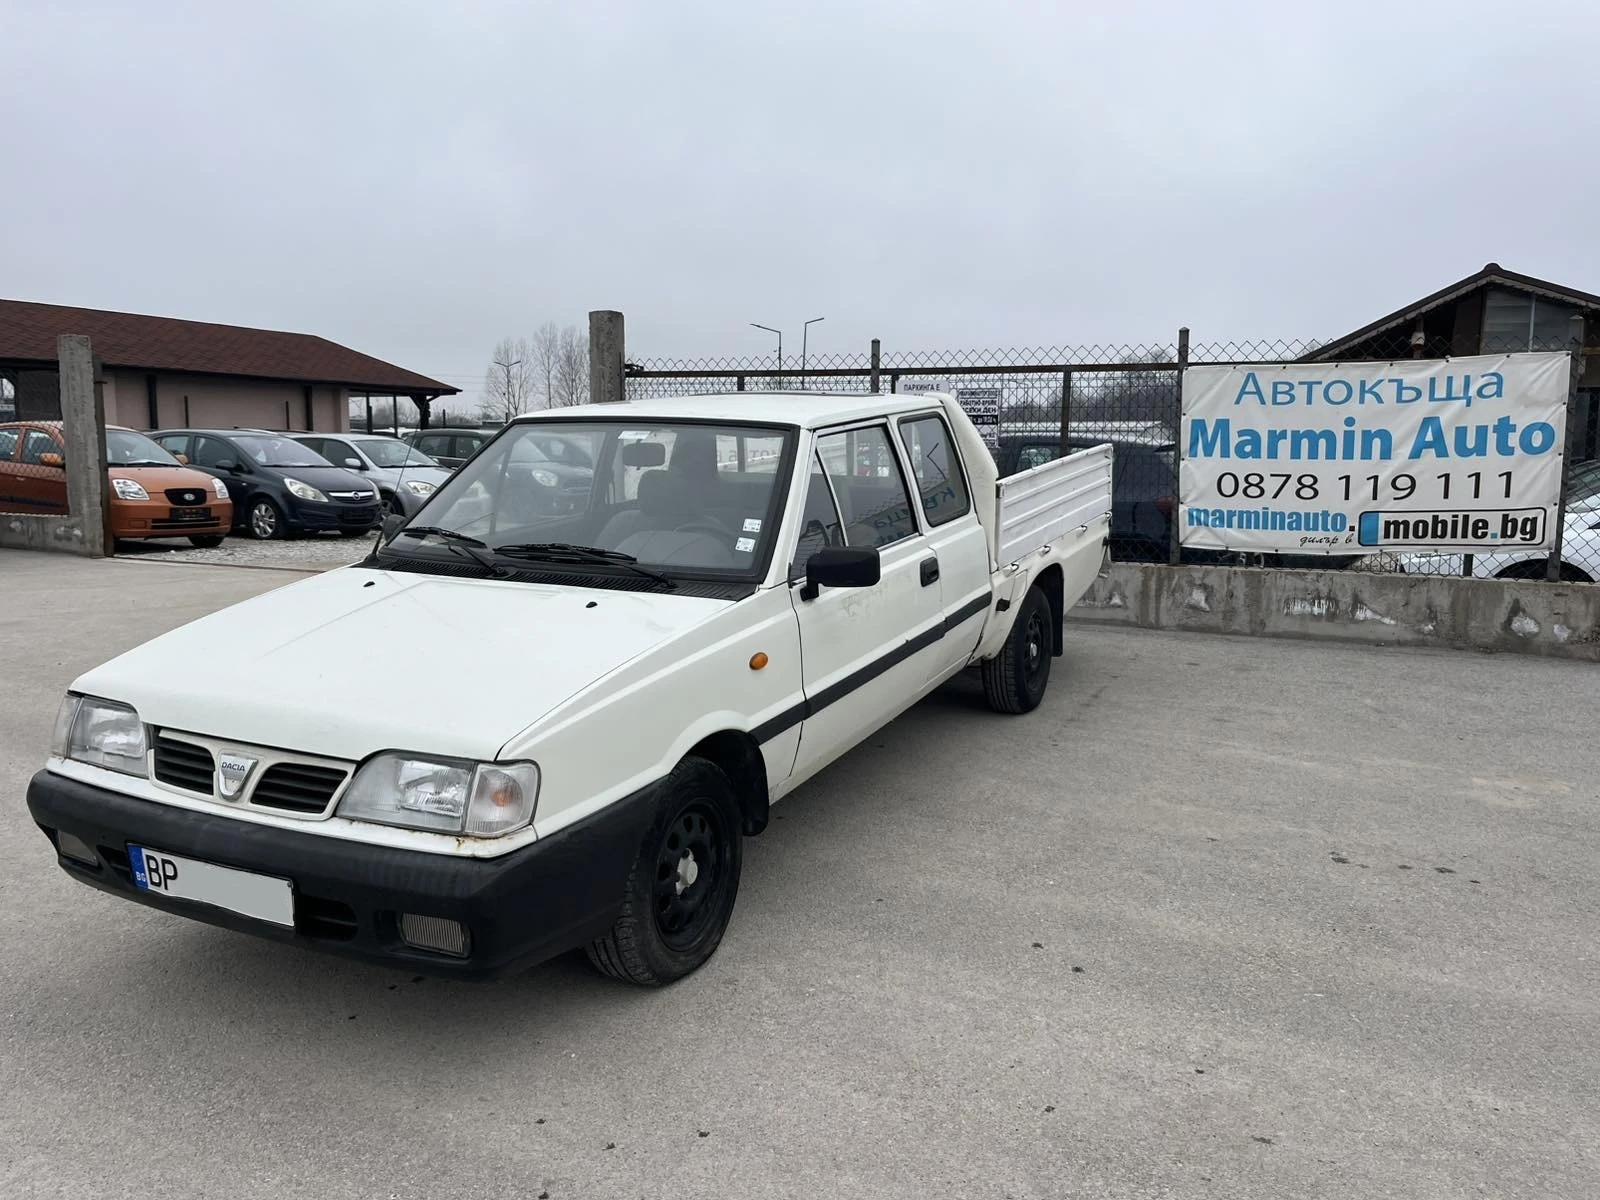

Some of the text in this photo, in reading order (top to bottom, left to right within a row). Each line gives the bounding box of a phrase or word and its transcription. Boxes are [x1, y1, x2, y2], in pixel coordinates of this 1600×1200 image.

[1234, 372, 1504, 407] Автокъща
[1188, 415, 1556, 460] Marmin Auto
[1217, 471, 1512, 500] 0878 119 111
[1383, 514, 1538, 542] mobile.bg
[221, 761, 246, 772] DACIA
[135, 854, 178, 890] BG BP
